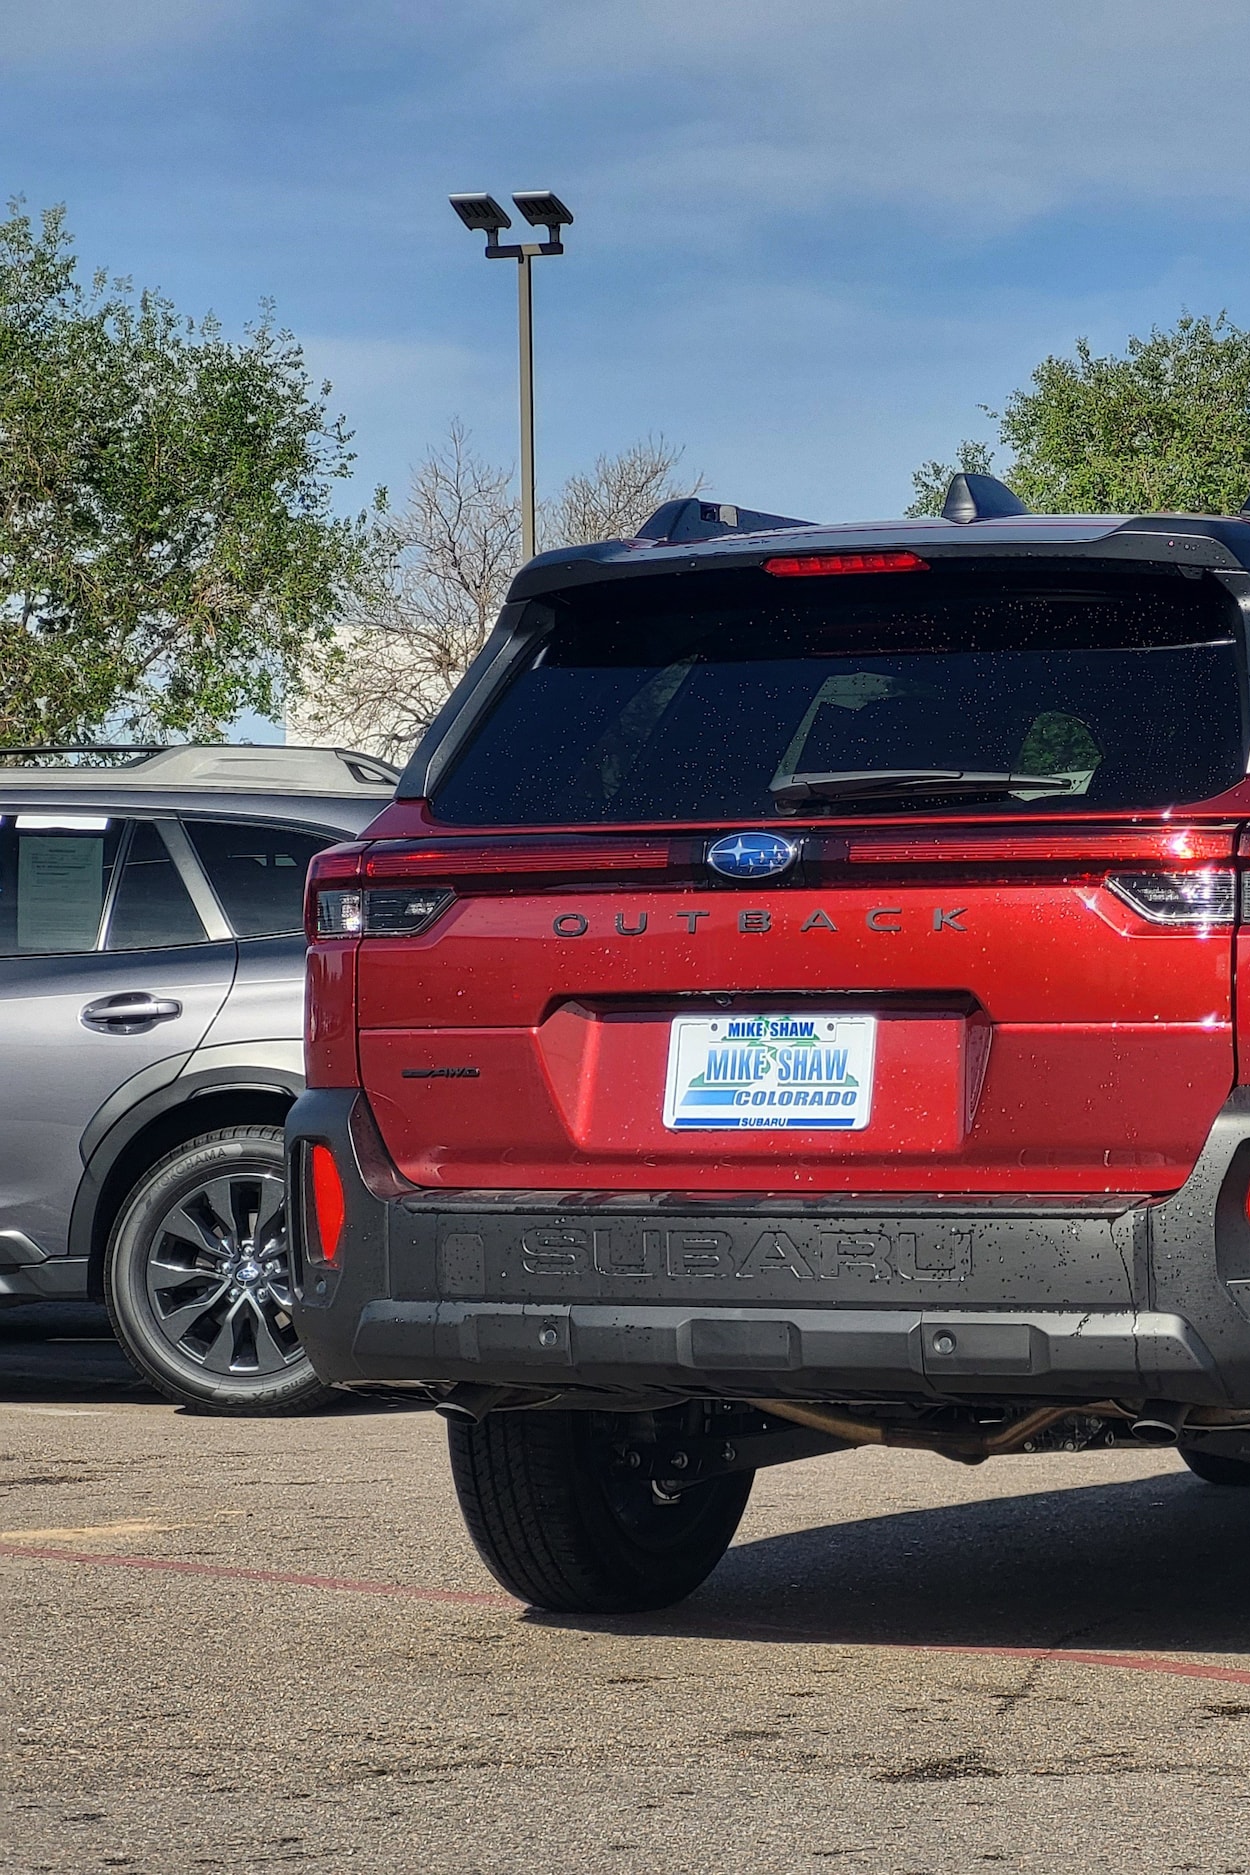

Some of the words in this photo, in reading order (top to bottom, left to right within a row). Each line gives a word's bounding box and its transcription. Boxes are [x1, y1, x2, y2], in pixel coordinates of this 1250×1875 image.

[552, 907, 969, 938] OUTBACK
[728, 1022, 764, 1037] MIKE
[770, 1021, 815, 1037] SHAW
[706, 1049, 767, 1081] MIKE
[777, 1049, 849, 1081] SHAW
[735, 1090, 858, 1106] COLORADO
[741, 1117, 787, 1127] SUBARU
[154, 1147, 228, 1193] YOKOHAMA
[521, 1227, 973, 1282] SUBARU
